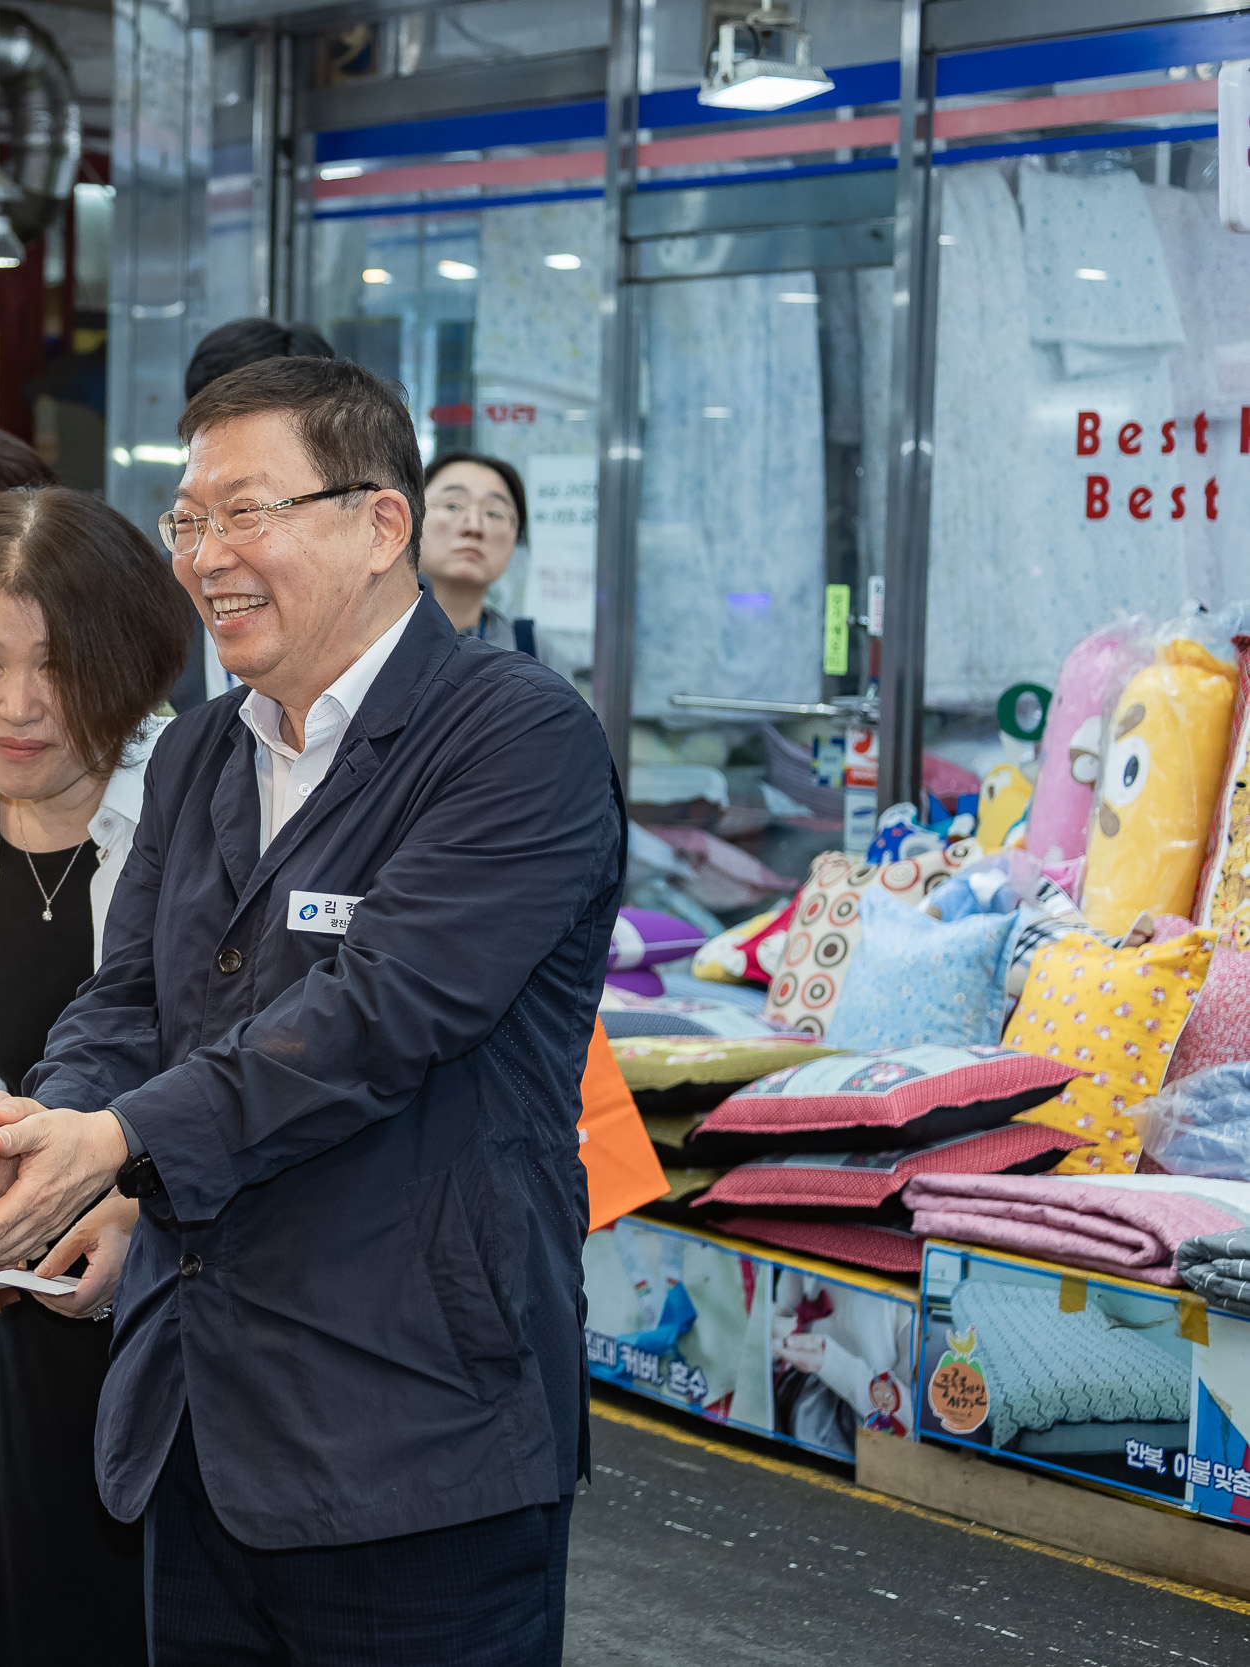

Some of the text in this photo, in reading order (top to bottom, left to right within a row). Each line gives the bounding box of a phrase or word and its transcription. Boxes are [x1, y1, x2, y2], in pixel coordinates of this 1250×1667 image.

[1076, 410, 1208, 457] Best
[1085, 473, 1219, 521] Best
[324, 900, 337, 915] 김
[1125, 1438, 1250, 1497] 한복, 이불 맞춤
